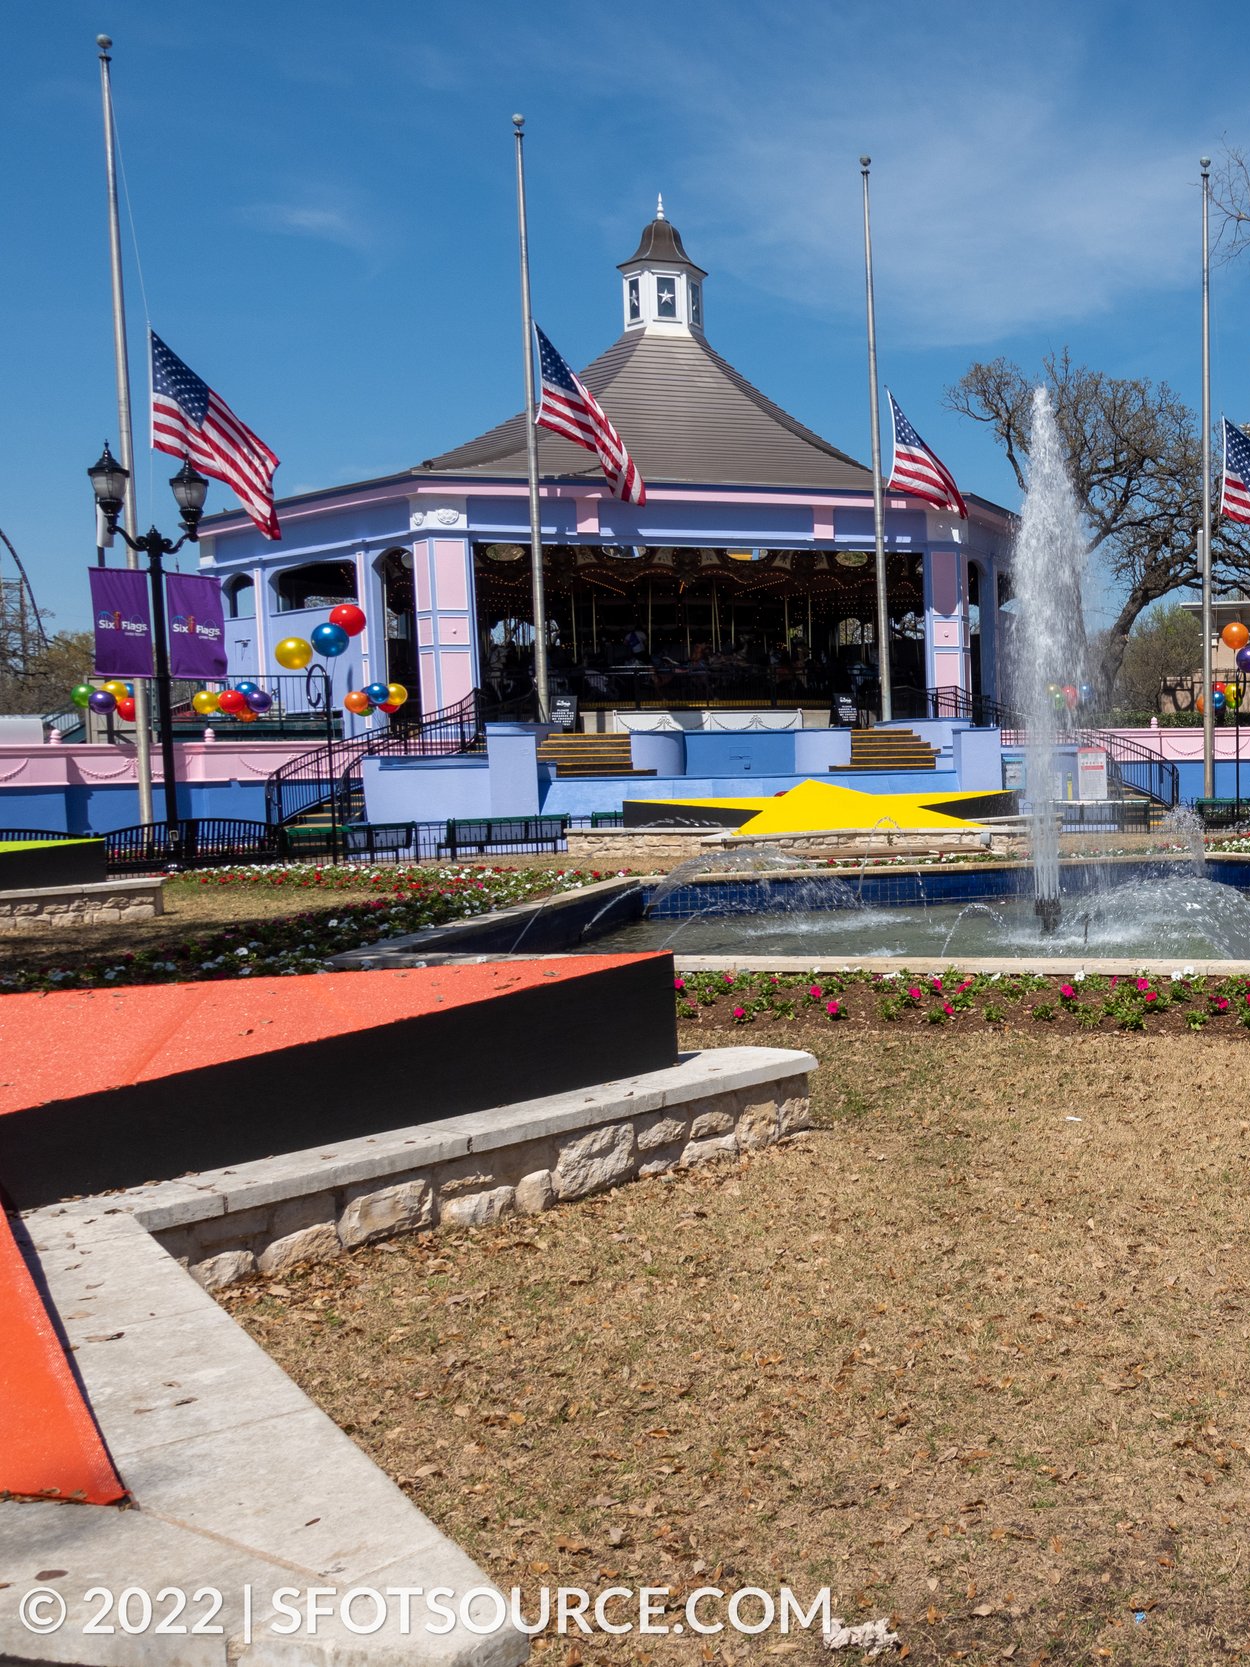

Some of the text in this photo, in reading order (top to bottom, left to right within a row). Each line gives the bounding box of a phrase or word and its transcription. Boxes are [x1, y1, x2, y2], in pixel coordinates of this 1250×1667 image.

[99, 620, 148, 632] Six Flags
[173, 624, 221, 636] Six Flags
